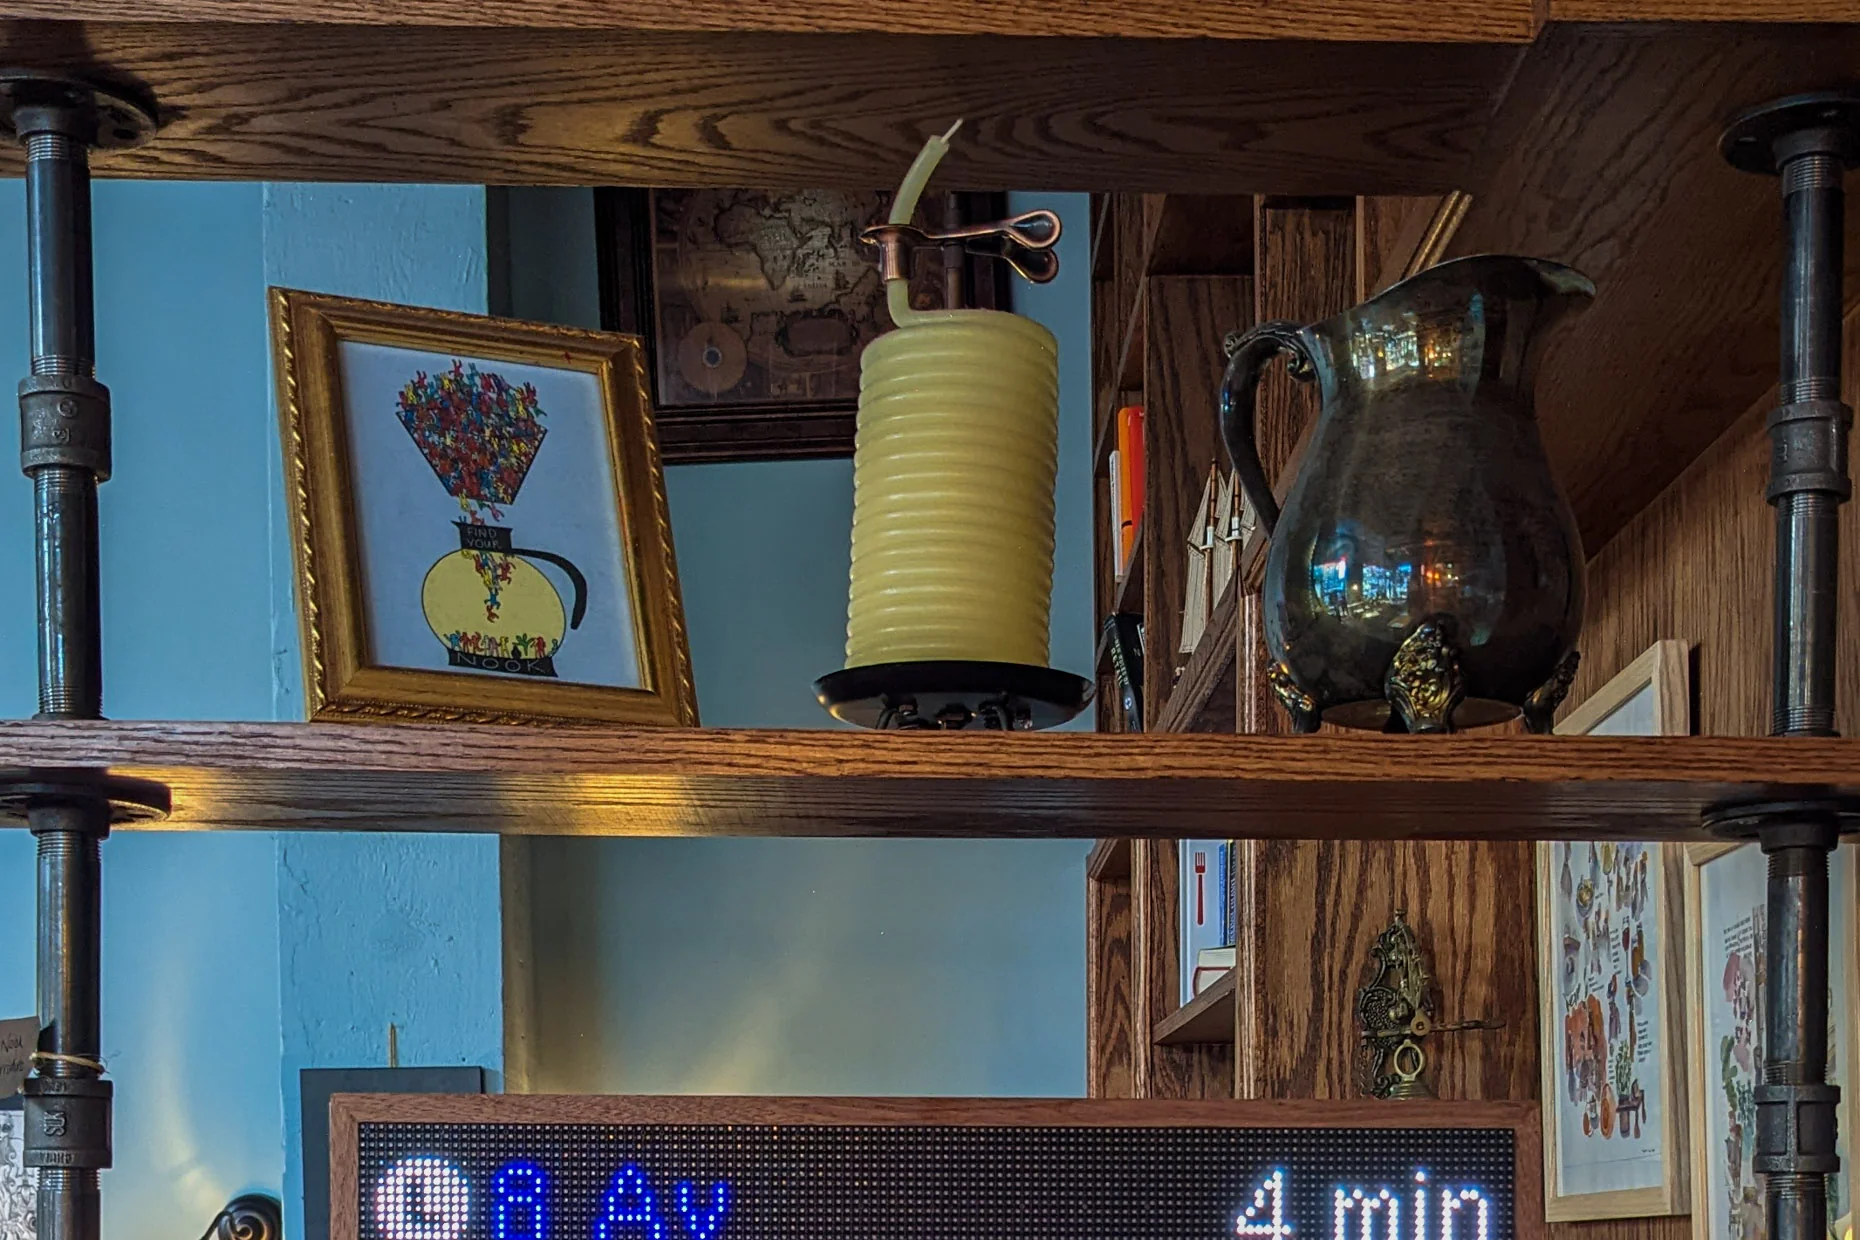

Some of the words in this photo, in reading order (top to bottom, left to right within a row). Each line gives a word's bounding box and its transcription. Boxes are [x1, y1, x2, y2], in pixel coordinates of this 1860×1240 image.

[466, 526, 498, 539] FIND
[466, 537, 500, 550] YOUR
[456, 652, 547, 674] NOOK
